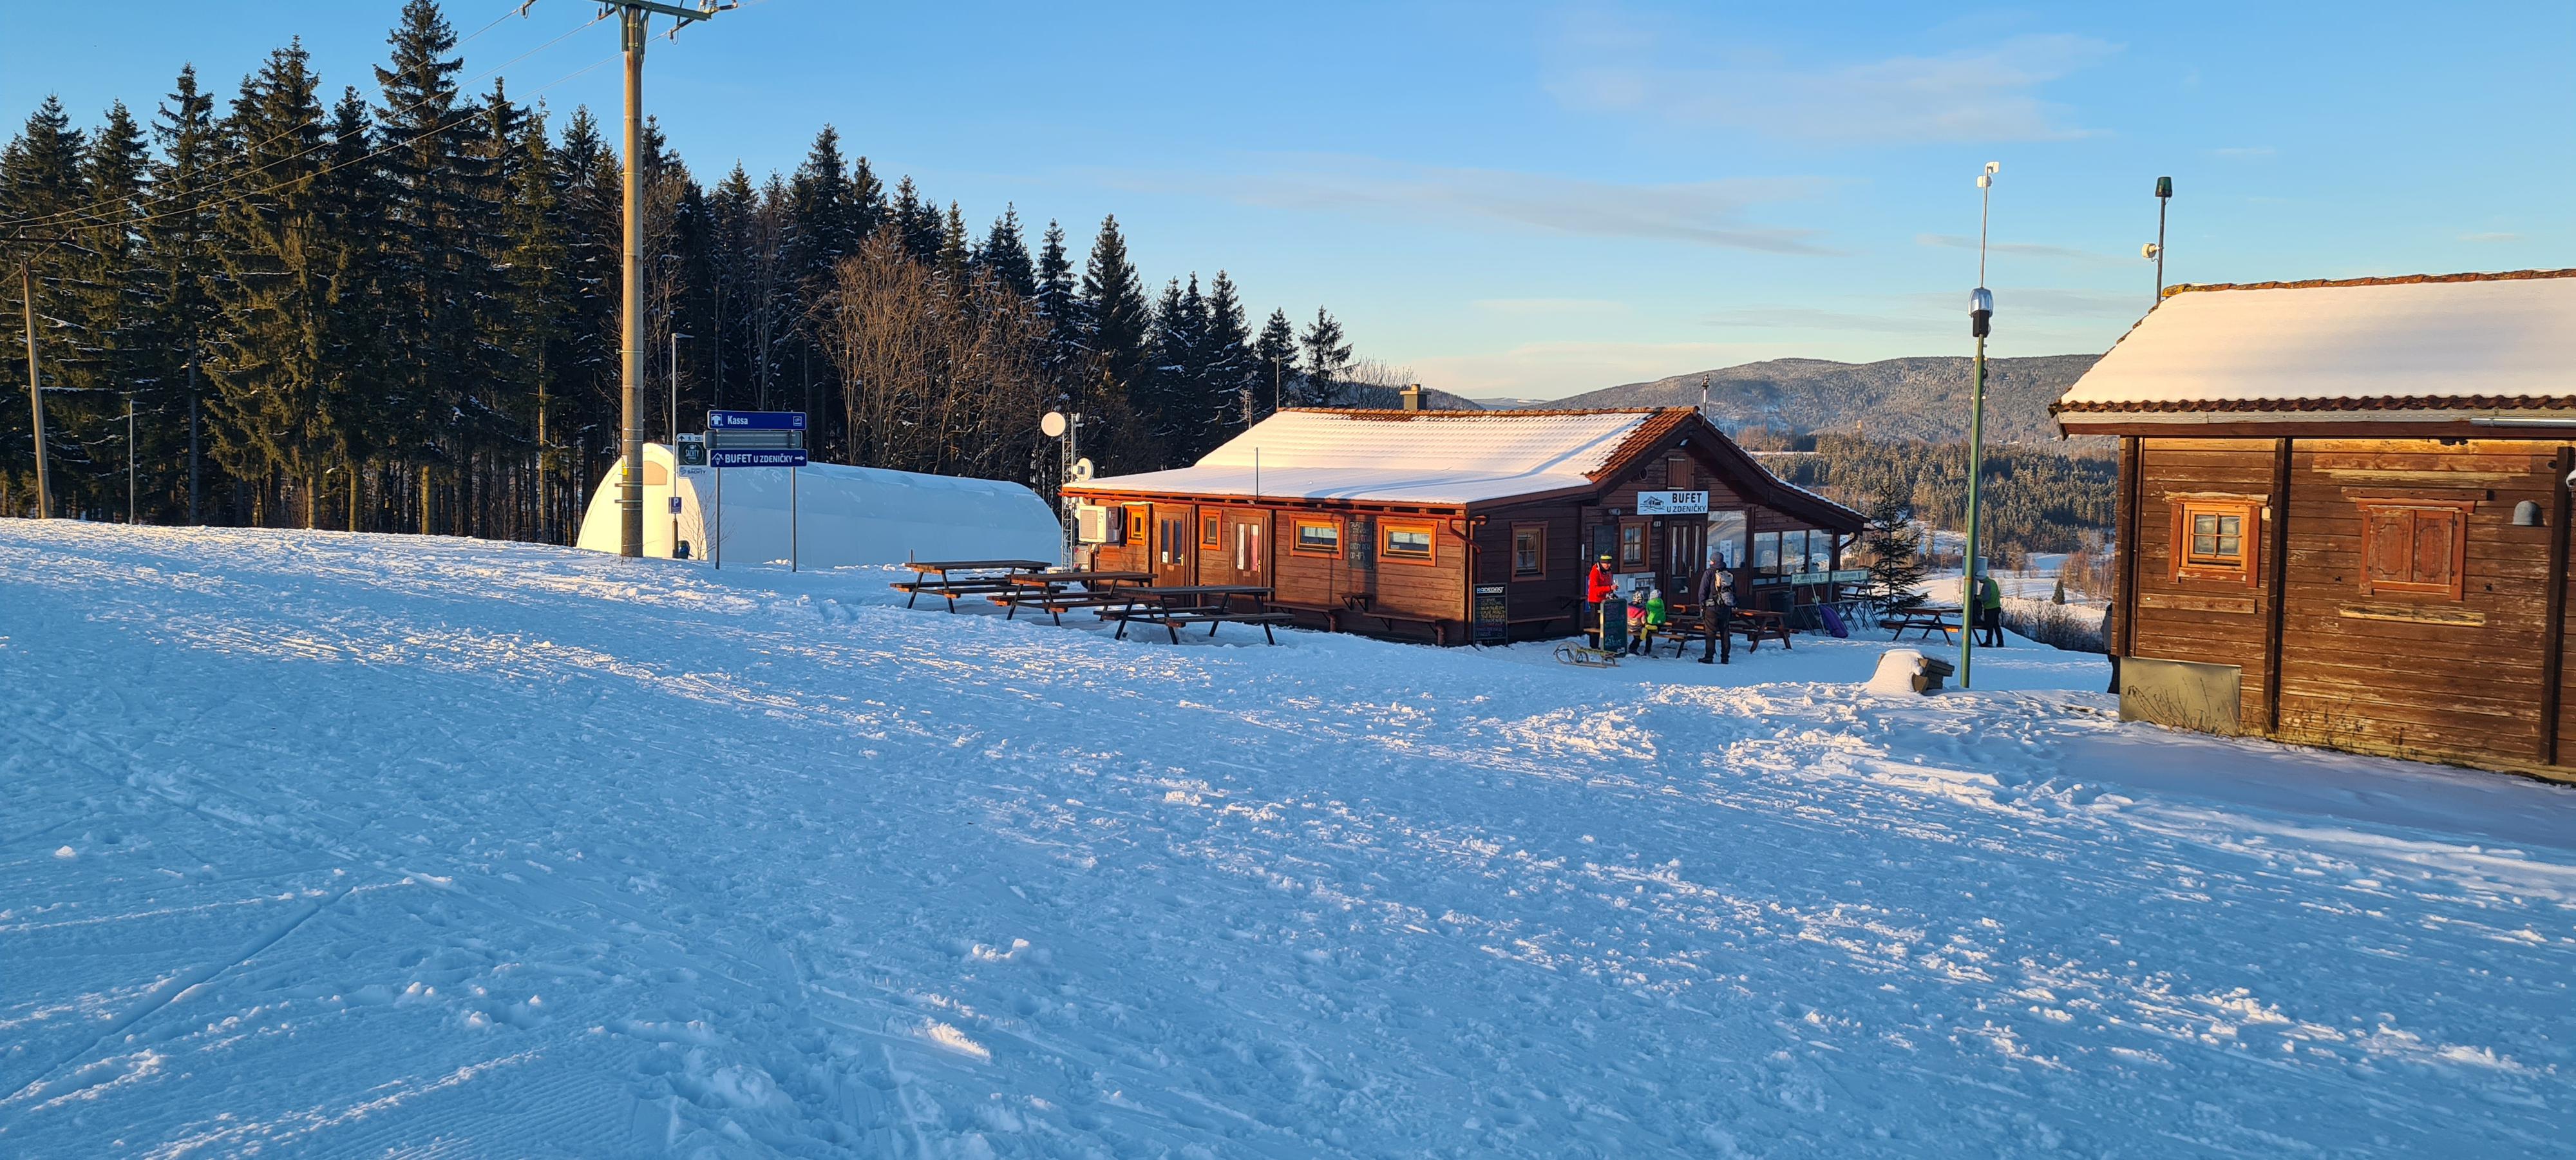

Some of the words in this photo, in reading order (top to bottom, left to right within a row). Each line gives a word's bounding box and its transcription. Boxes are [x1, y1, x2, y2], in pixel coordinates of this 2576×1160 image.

[727, 415, 748, 425] Kassa
[724, 453, 752, 463] BUFET
[753, 455, 759, 463] U
[759, 453, 793, 463] ZDENIČKY
[674, 498, 679, 507] P
[1672, 493, 1702, 503] BUFET
